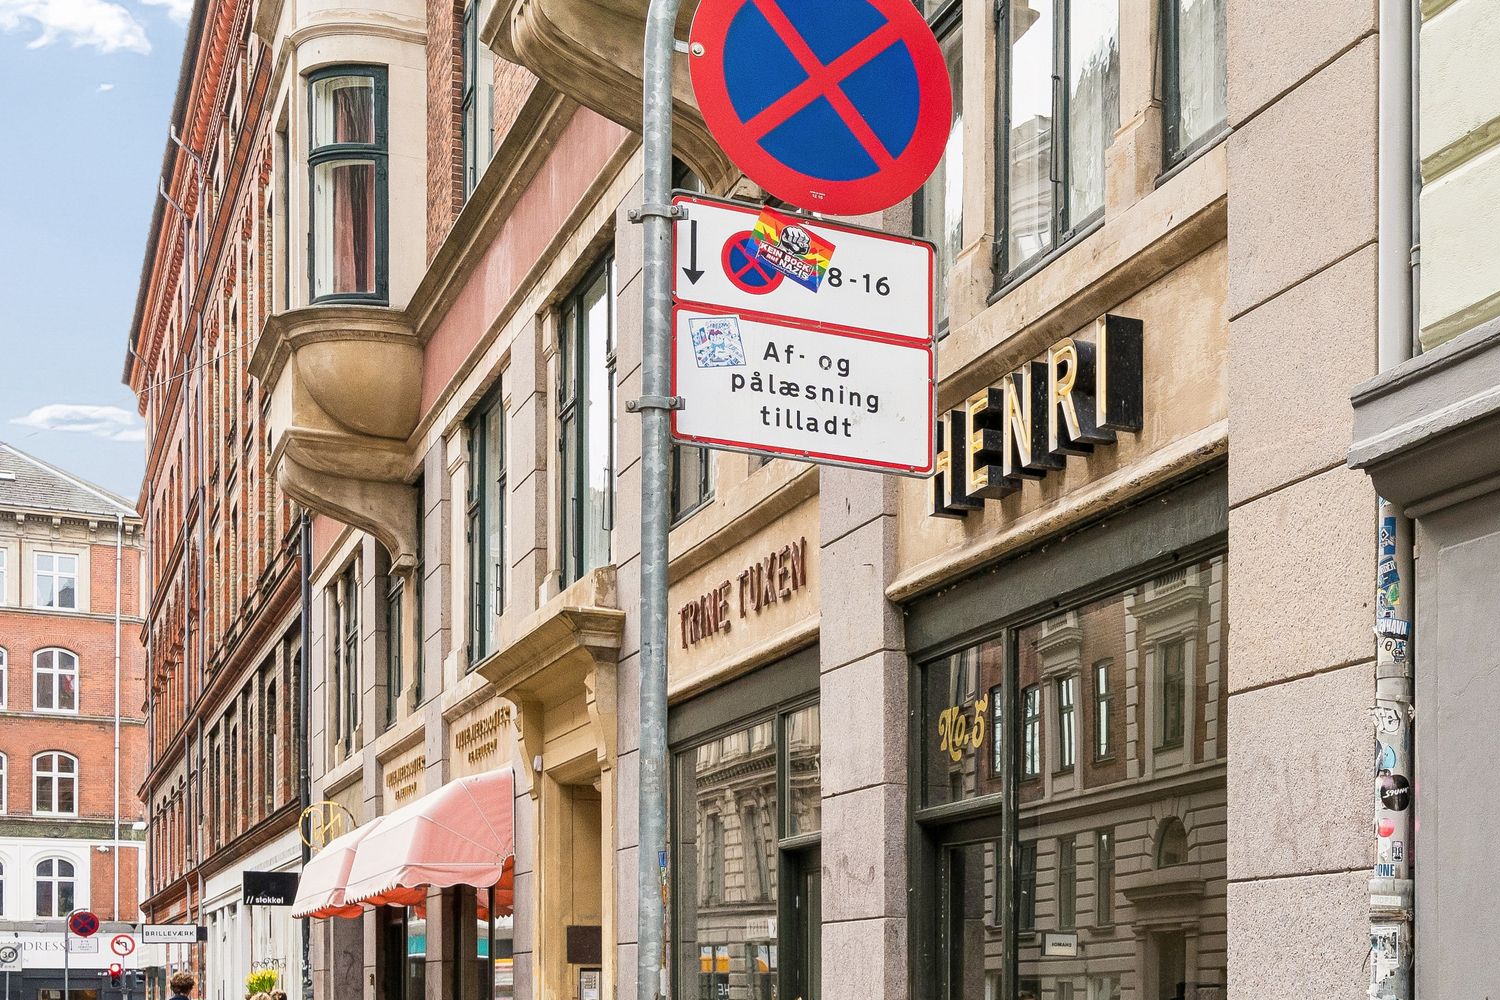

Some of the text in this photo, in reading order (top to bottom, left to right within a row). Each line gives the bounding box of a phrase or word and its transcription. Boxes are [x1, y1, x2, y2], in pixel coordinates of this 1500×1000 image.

[760, 241, 810, 273] KEIN BOCK
[766, 252, 810, 280] auf NAZIS
[763, 341, 850, 377] Af- og
[731, 371, 879, 413] pålæsning
[760, 406, 851, 437] tilladt
[928, 313, 1143, 519] HENRI
[736, 536, 807, 619] TUXEN
[972, 694, 988, 748] 5
[1375, 863, 1395, 877] ONE
